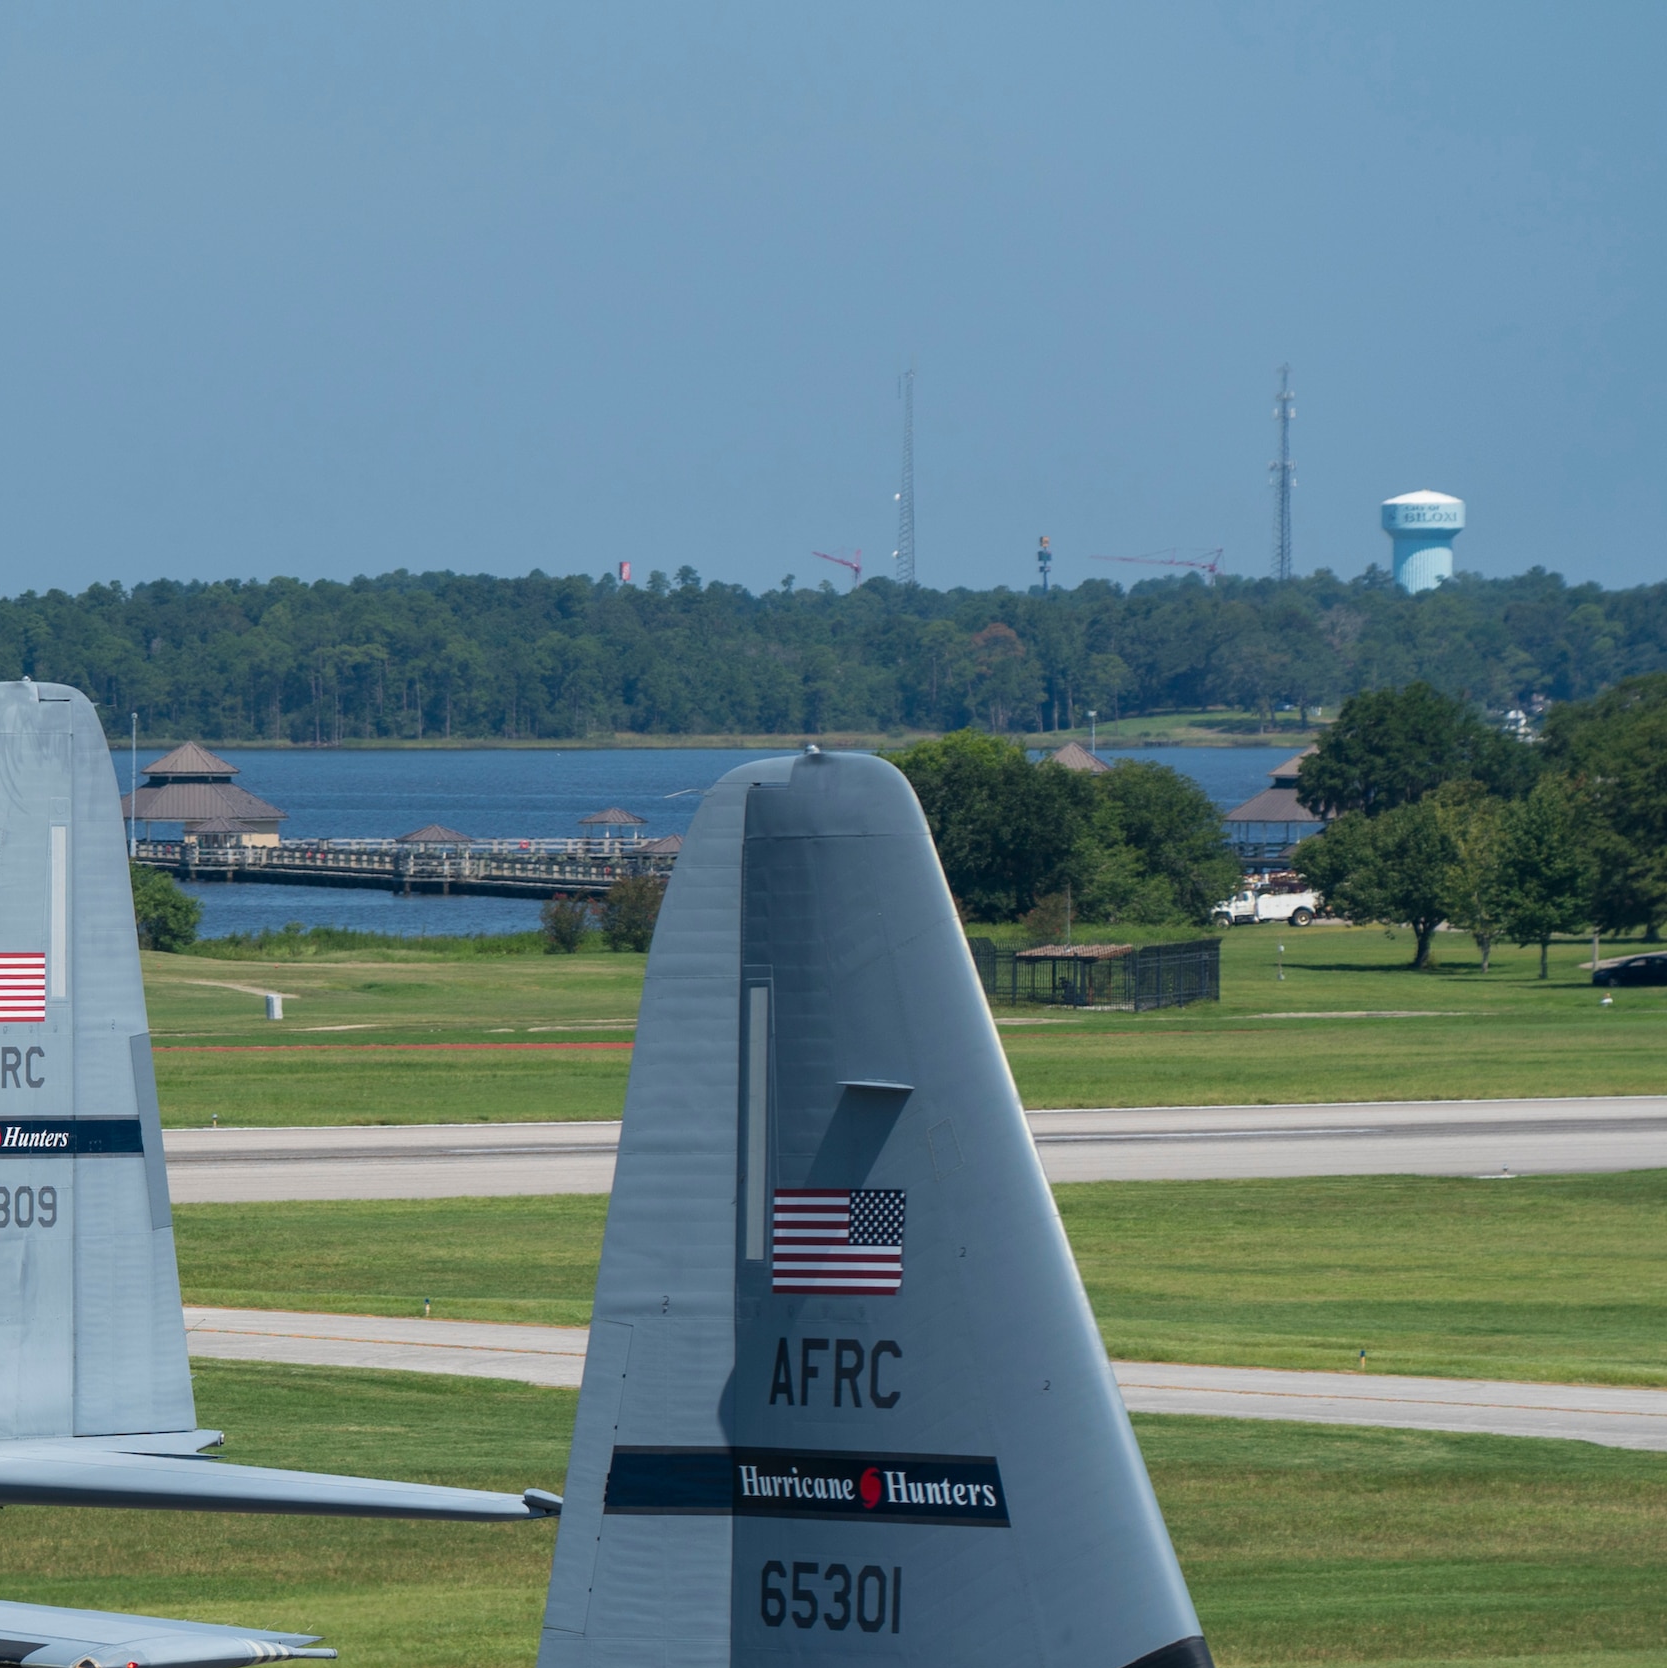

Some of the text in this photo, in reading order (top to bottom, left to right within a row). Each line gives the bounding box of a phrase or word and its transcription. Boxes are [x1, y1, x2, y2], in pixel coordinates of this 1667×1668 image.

[1405, 512, 1457, 522] BILOXI
[2, 1126, 69, 1148] Hunters
[959, 1247, 967, 1258] 2
[769, 1337, 903, 1409] AFRC
[1043, 1380, 1051, 1391] 2
[739, 1465, 997, 1507] Hurricane Hunters
[761, 1560, 902, 1634] 65301
